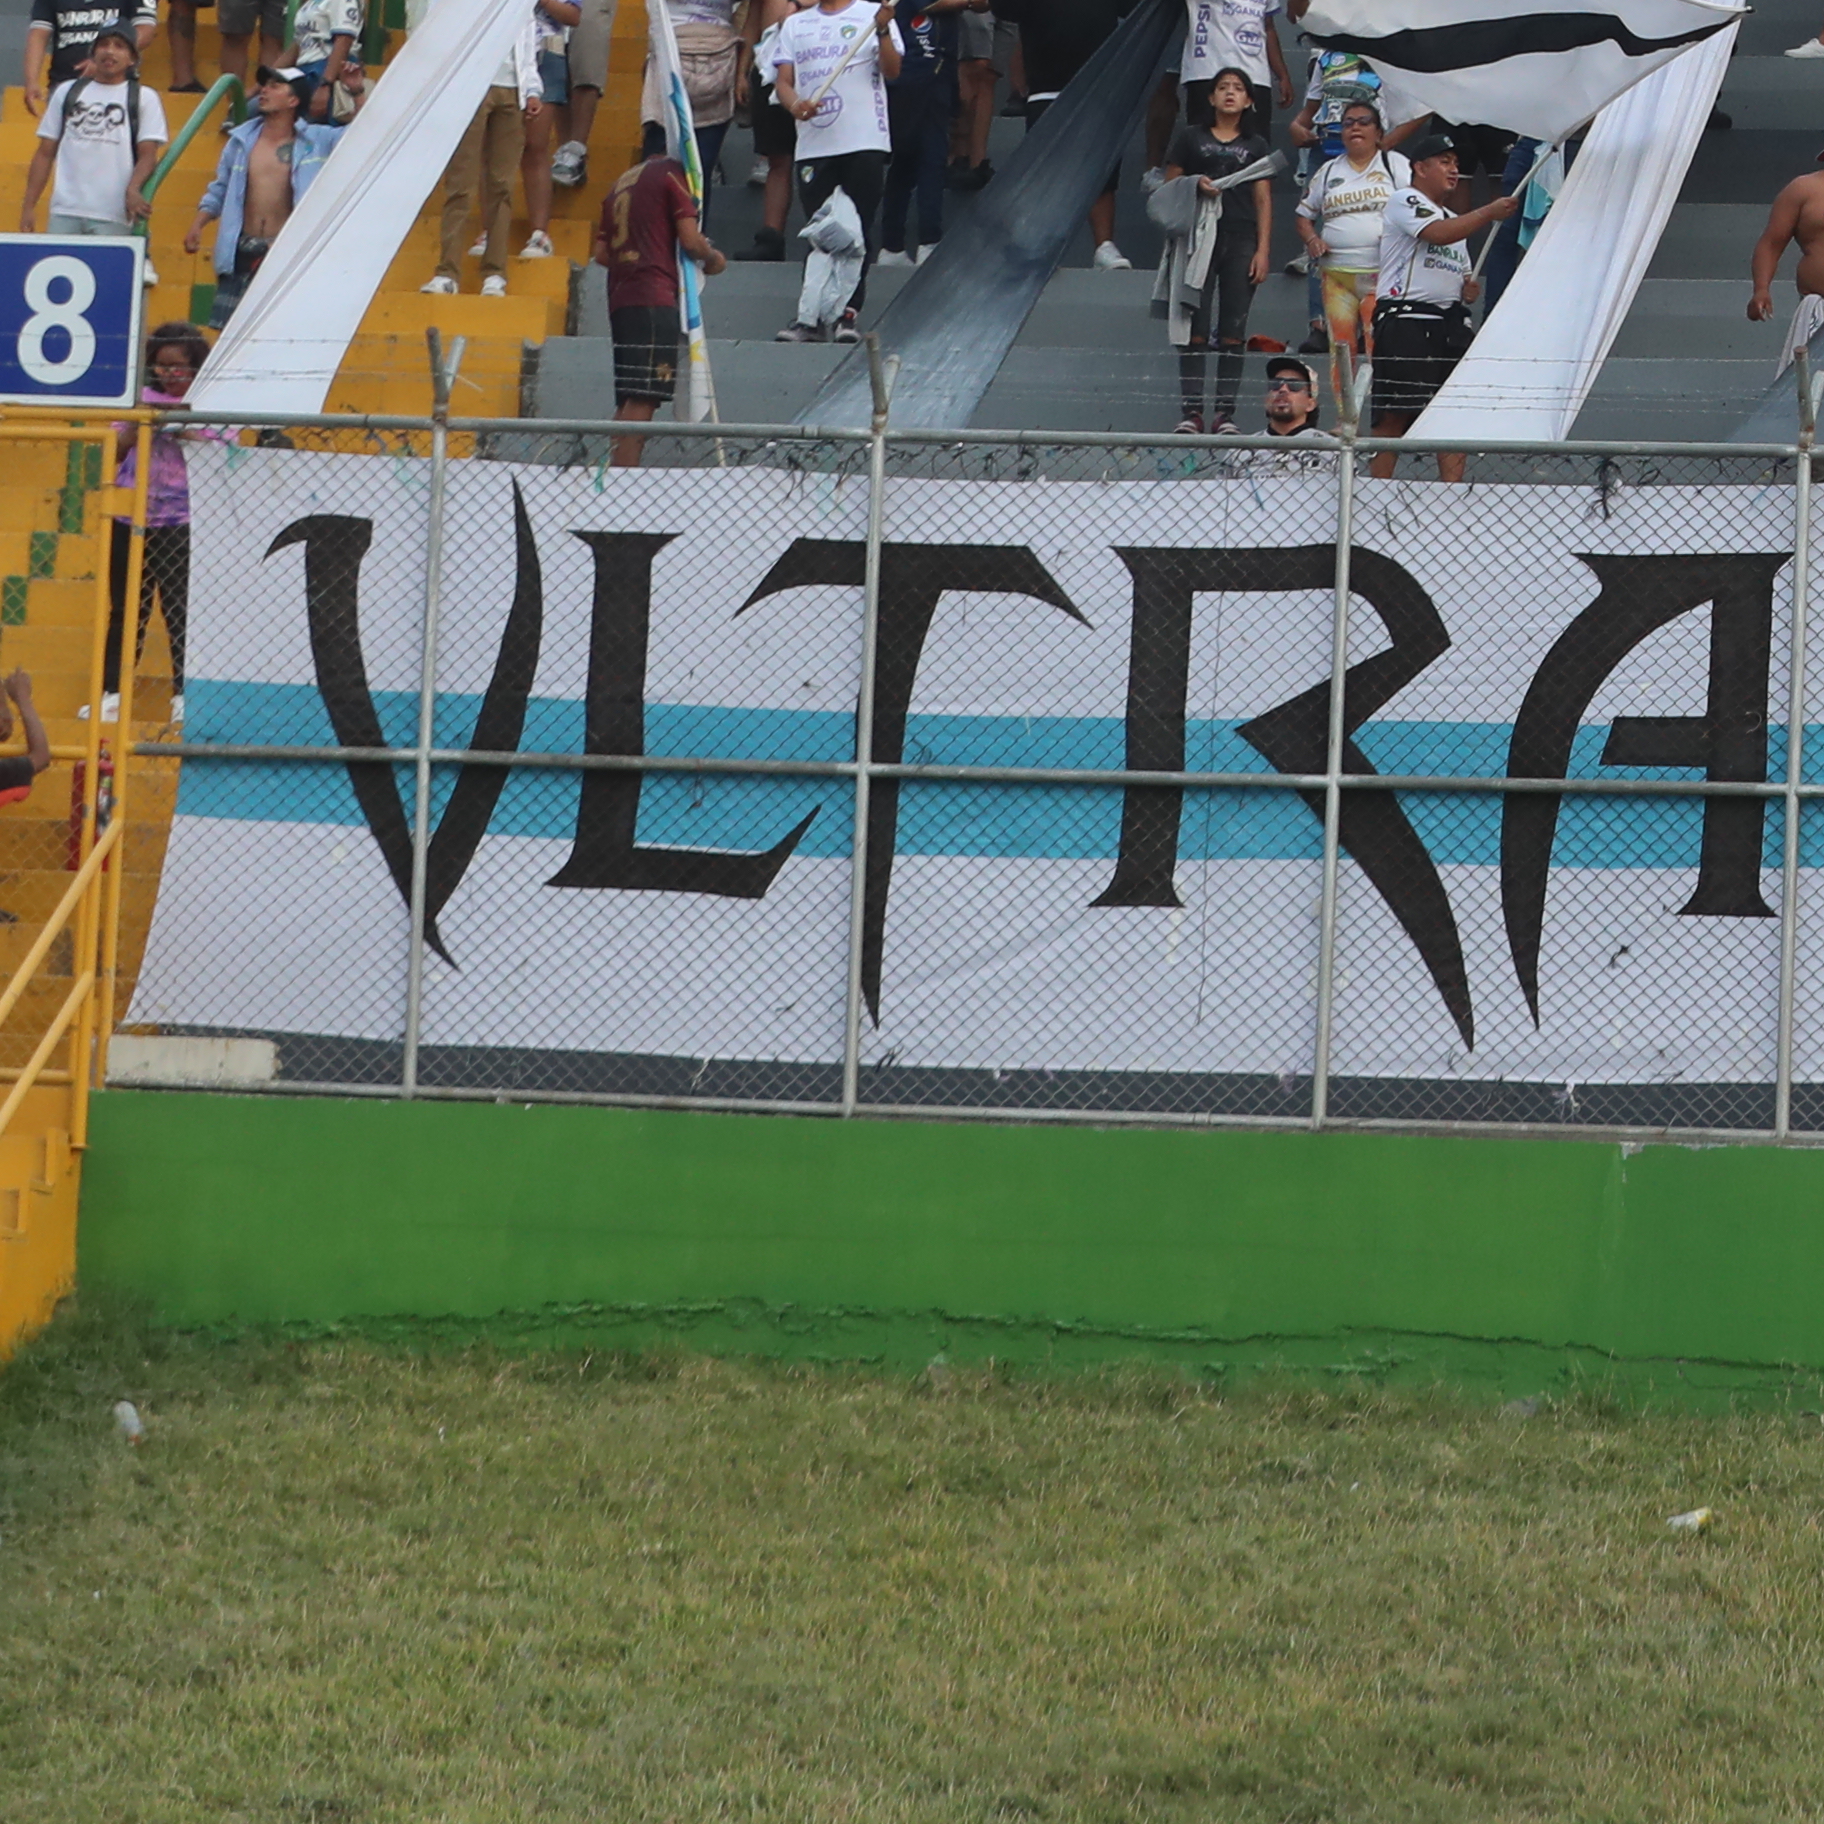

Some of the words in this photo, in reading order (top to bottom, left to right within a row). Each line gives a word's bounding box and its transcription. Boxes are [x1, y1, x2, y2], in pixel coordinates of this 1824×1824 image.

[1194, 4, 1211, 59] PEPSI
[795, 44, 854, 65] BANRURA
[1322, 186, 1390, 207] BANRURAL
[1427, 243, 1464, 263] BANRURA
[17, 256, 97, 385] 8
